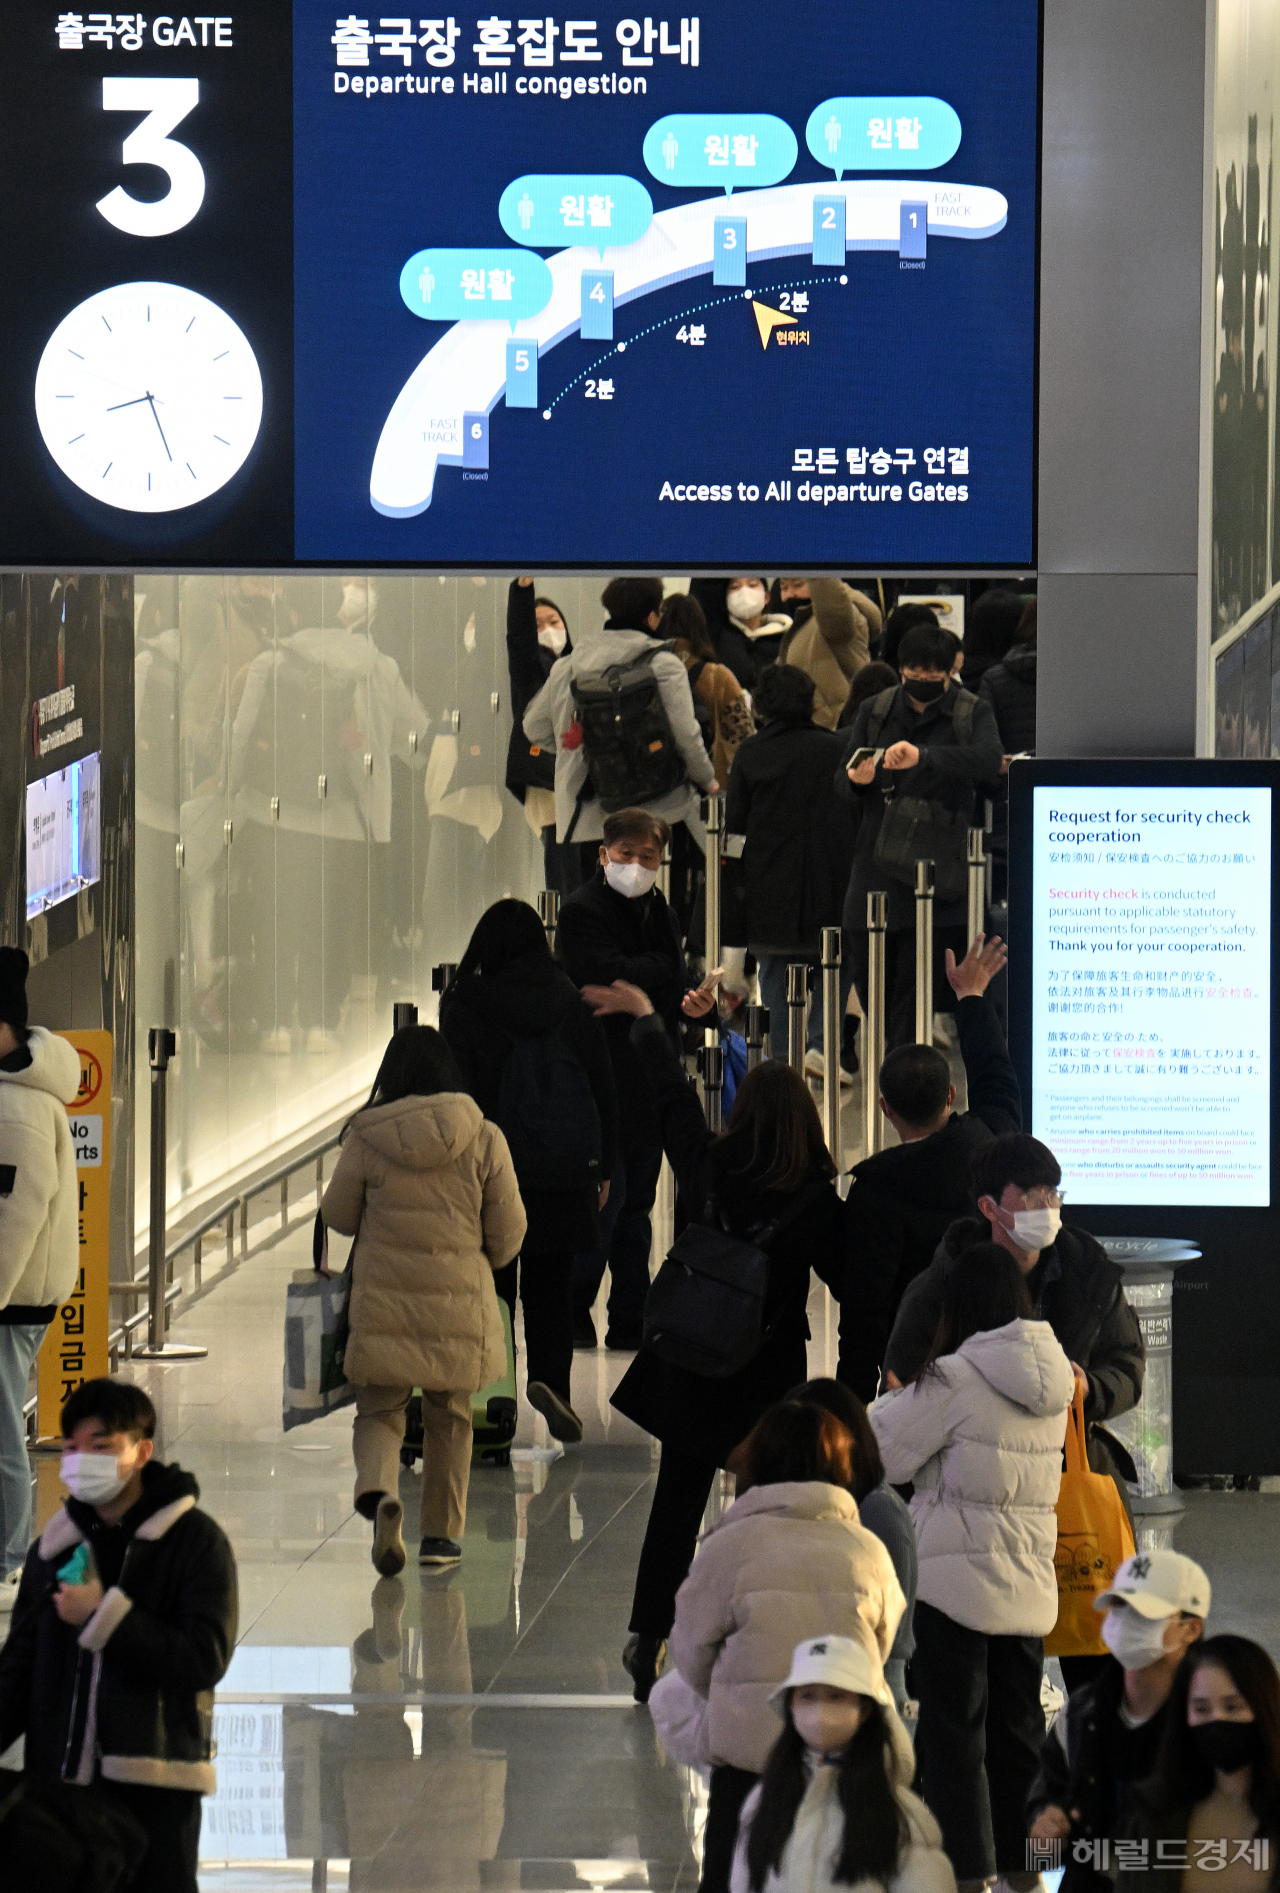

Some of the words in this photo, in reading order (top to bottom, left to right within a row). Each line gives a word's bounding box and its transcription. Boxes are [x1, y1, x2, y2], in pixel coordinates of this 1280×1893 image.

[54, 12, 148, 52] 출국장
[152, 16, 233, 48] GATE
[330, 14, 461, 68] 출국장
[472, 16, 603, 66] 혼잡도
[615, 16, 700, 68] 안내
[334, 72, 455, 98] Departure
[463, 72, 507, 94] Hall
[515, 72, 647, 100] congestion
[866, 116, 922, 150] 원활
[95, 76, 206, 238] 3
[704, 134, 759, 166] 원활
[934, 192, 964, 204] FAST
[559, 194, 615, 228] 원활
[821, 206, 837, 230] 2
[934, 206, 972, 216] TRACK
[909, 212, 917, 229] 1
[722, 227, 737, 251] 3
[900, 261, 926, 270] (Closed)
[460, 268, 515, 300] 원활
[589, 281, 606, 304] 4
[778, 290, 810, 313] 2분
[675, 324, 707, 346] 4분
[776, 330, 810, 346] 현위치
[515, 349, 530, 373] 5
[584, 378, 615, 400] 2분
[430, 418, 458, 430] FAST
[471, 422, 483, 440] 6
[422, 432, 458, 442] TRACK
[791, 448, 840, 474] 모든
[846, 446, 917, 476] 탑승구
[923, 446, 969, 474] 연결
[462, 472, 488, 482] (Closed)
[658, 480, 733, 502] Access
[736, 482, 760, 502] to
[764, 480, 791, 502] All
[797, 480, 903, 506] departure
[908, 480, 969, 502] Gates
[1049, 809, 1112, 826] Request
[1115, 808, 1138, 824] for
[1141, 809, 1202, 827] security
[1206, 809, 1251, 824] check
[1048, 828, 1141, 846] cooperation
[1049, 888, 1100, 902] Security
[1102, 888, 1138, 899] check
[1141, 888, 1151, 900] is
[1153, 888, 1216, 900] conducted
[1049, 906, 1101, 919] pursuant
[1104, 906, 1117, 917] to
[1119, 905, 1180, 920] applicable
[1182, 907, 1236, 920] statutory
[1049, 922, 1128, 937] requirements
[1130, 922, 1145, 934] for
[1149, 923, 1218, 937] passenger's
[1221, 923, 1258, 937] safety.
[1048, 939, 1087, 951] Thank
[1090, 942, 1113, 954] you
[1116, 939, 1132, 951] for
[1136, 943, 1163, 954] your
[1168, 940, 1246, 954] cooperation.
[1050, 1093, 1090, 1104] Passengers
[1105, 1094, 1122, 1103] their
[1123, 1094, 1163, 1105] belongings
[1049, 1104, 1076, 1113] anyone
[1077, 1103, 1093, 1112] who
[1049, 1113, 1061, 1123] get
[1073, 1113, 1102, 1122] airplane.
[1050, 1127, 1077, 1136] Anyone
[1122, 1128, 1162, 1137] prohibited
[1130, 1137, 1135, 1146] 2
[76, 1144, 98, 1160] rts
[1111, 1146, 1121, 1155] 20
[1122, 1146, 1149, 1155] million
[1165, 1162, 1195, 1171] security
[1115, 1171, 1139, 1180] prison
[1139, 1171, 1148, 1180] or
[1101, 1240, 1158, 1251] ecycle
